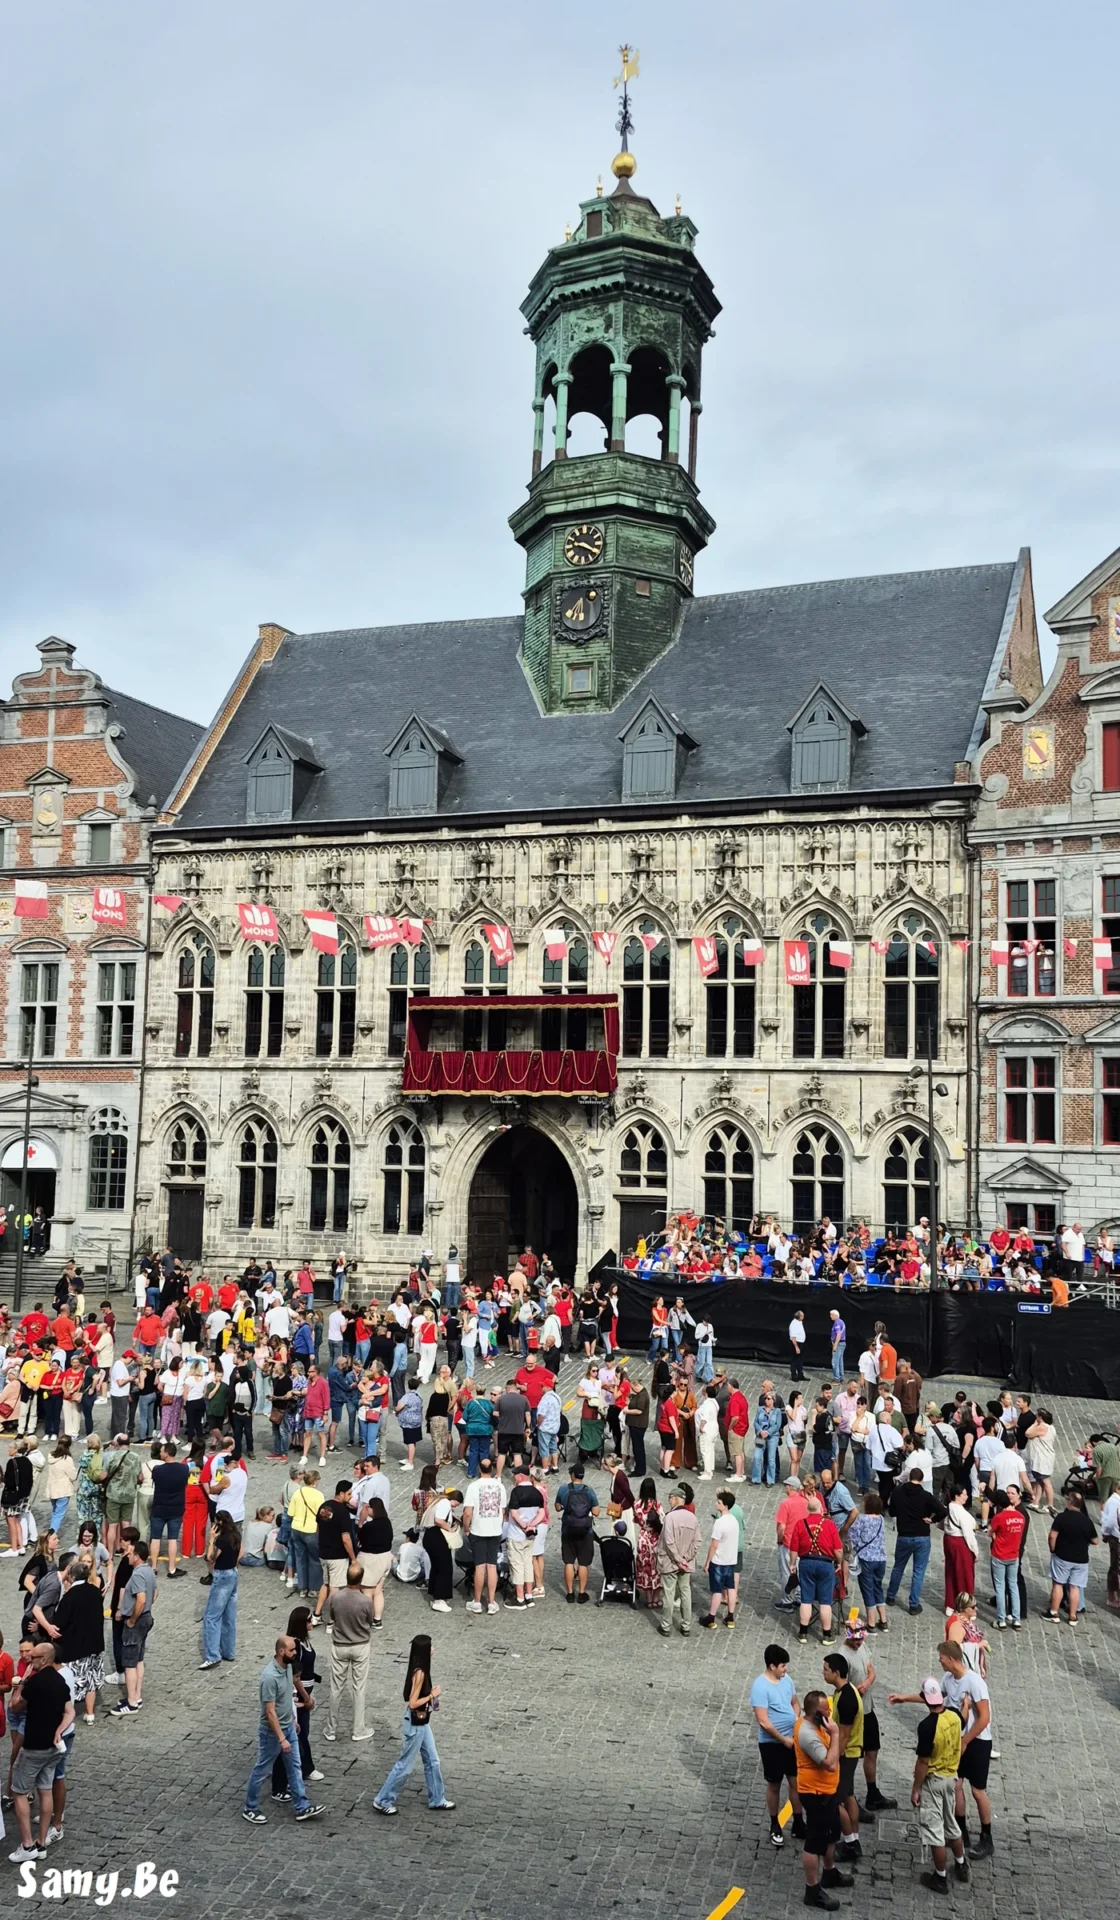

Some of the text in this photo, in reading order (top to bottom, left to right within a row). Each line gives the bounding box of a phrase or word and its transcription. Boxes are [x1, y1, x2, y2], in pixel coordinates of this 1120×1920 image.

[94, 909, 123, 920] MONS
[245, 927, 274, 936] MONS
[370, 932, 398, 942] MONS
